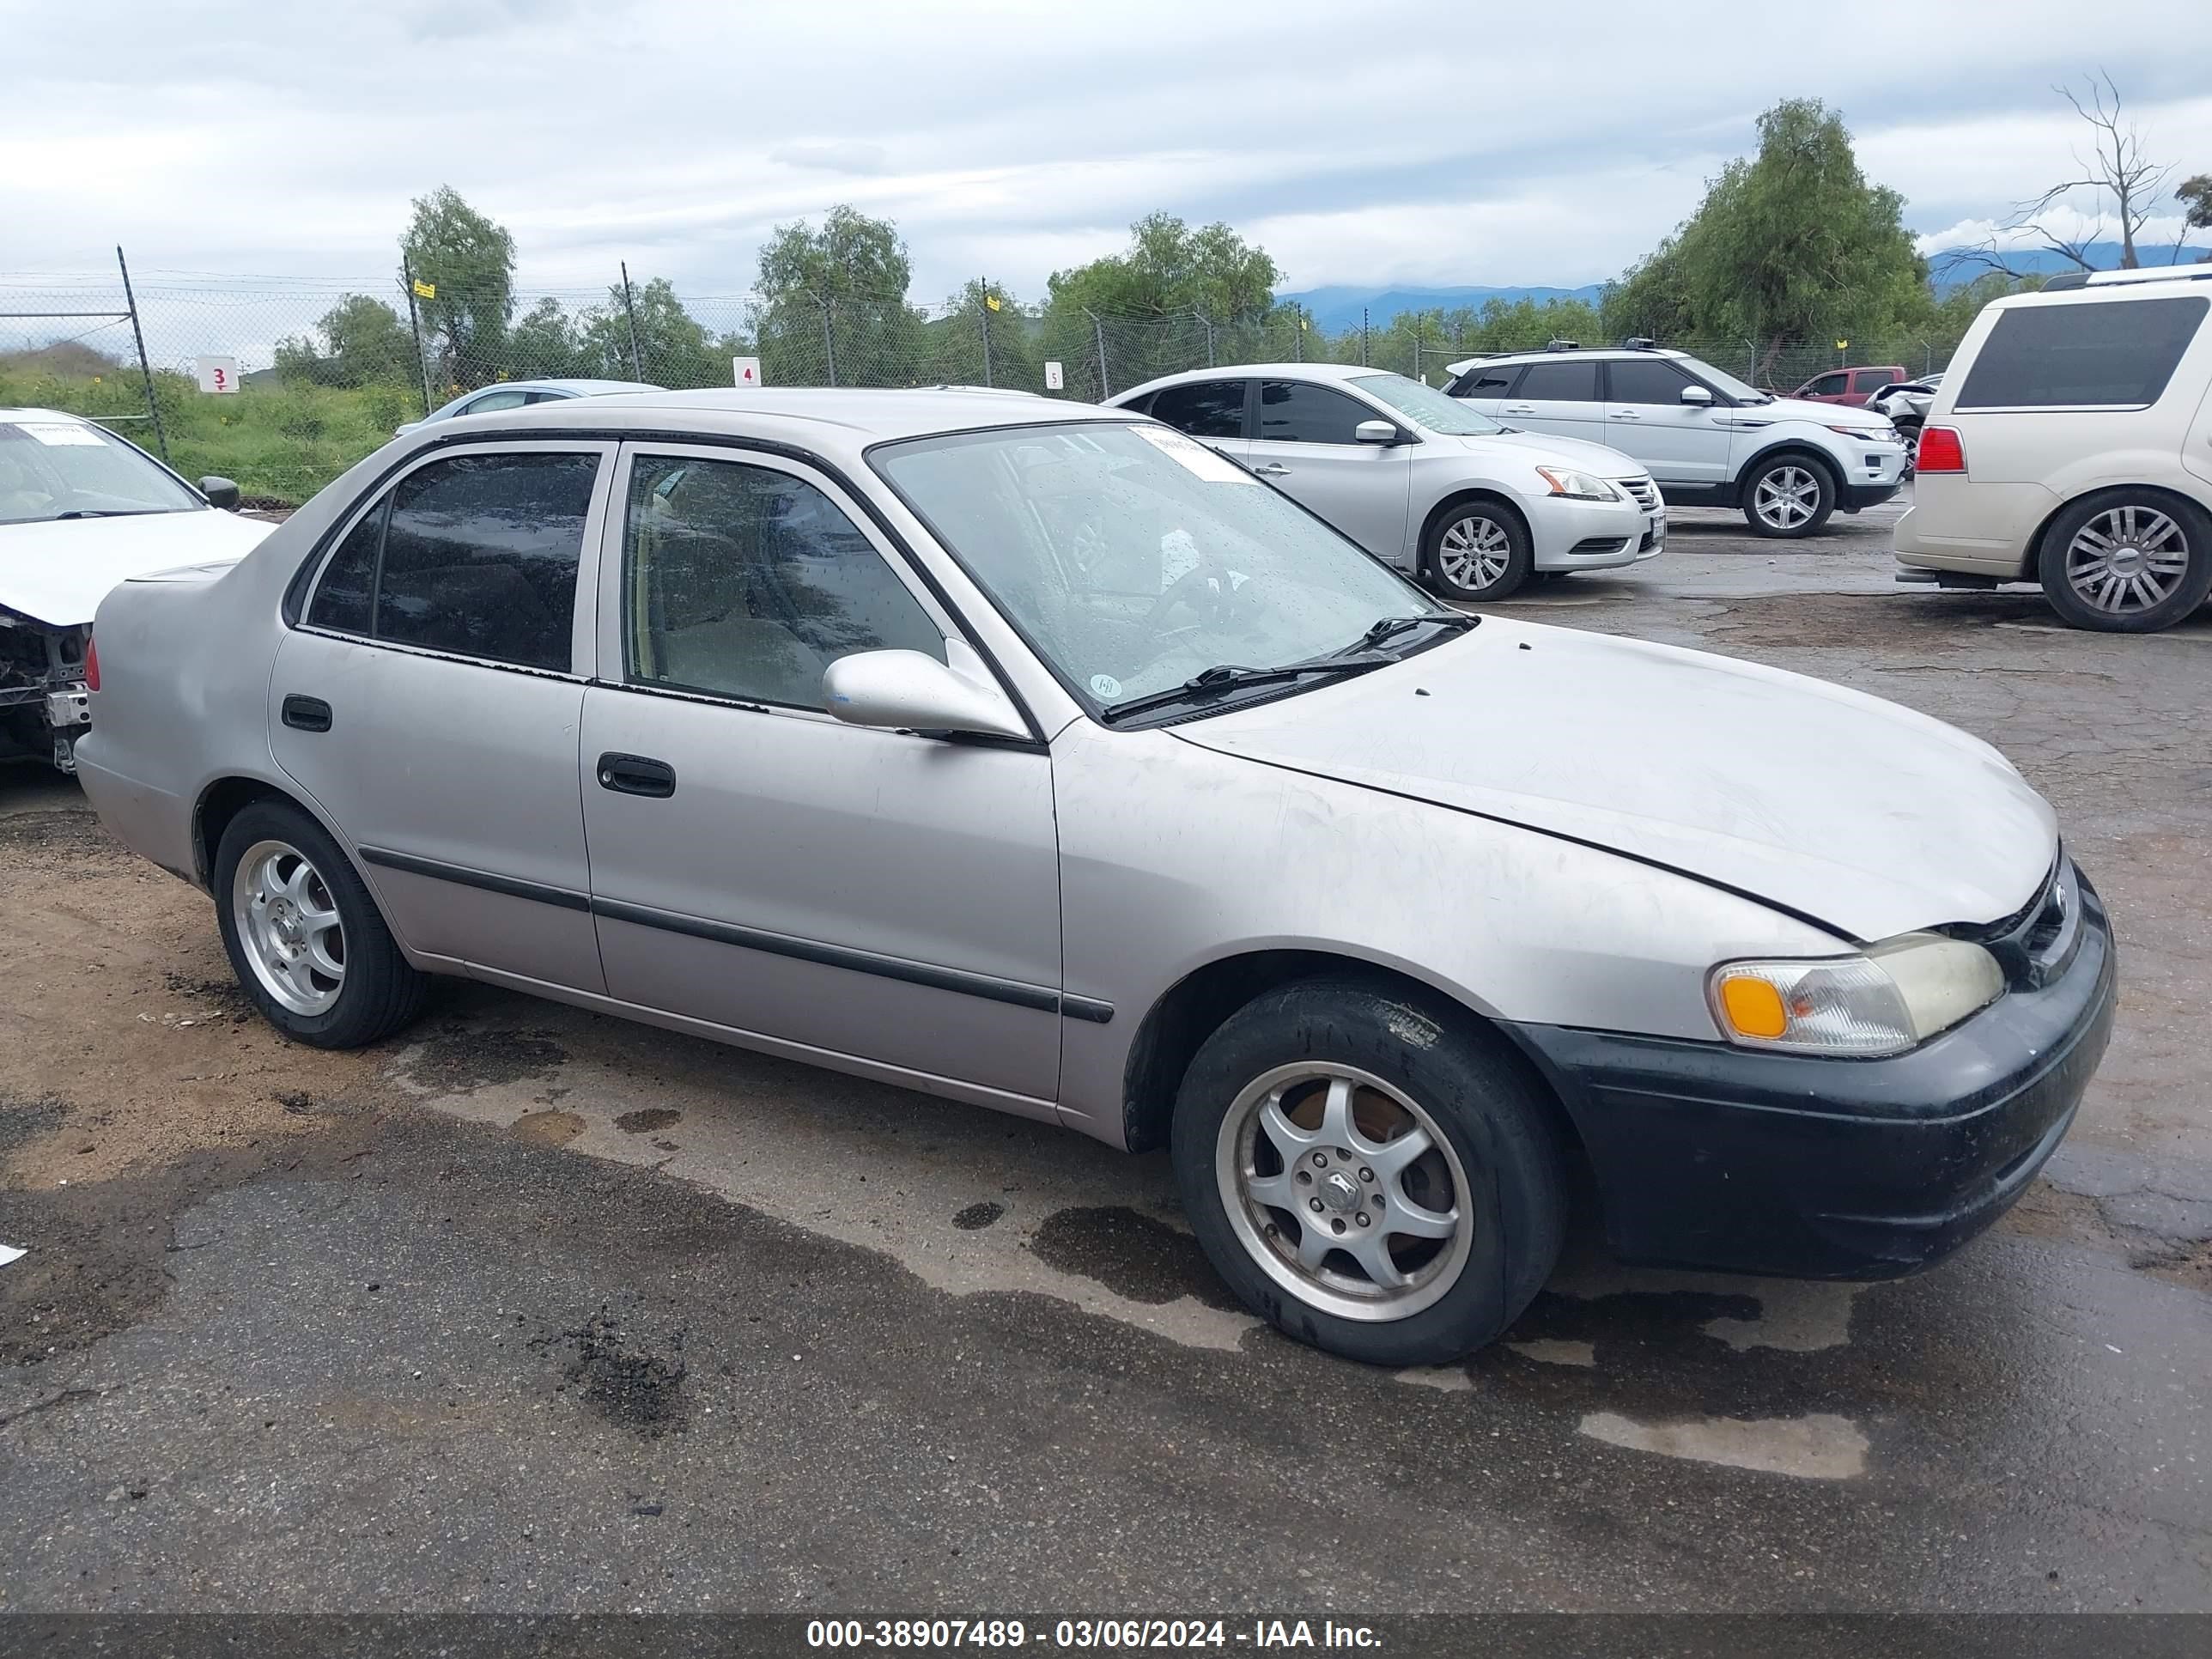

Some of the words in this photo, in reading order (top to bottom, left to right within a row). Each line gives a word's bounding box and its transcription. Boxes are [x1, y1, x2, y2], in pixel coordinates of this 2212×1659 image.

[214, 368, 225, 384] 3
[744, 368, 752, 380] 4
[1052, 373, 1057, 384] 5
